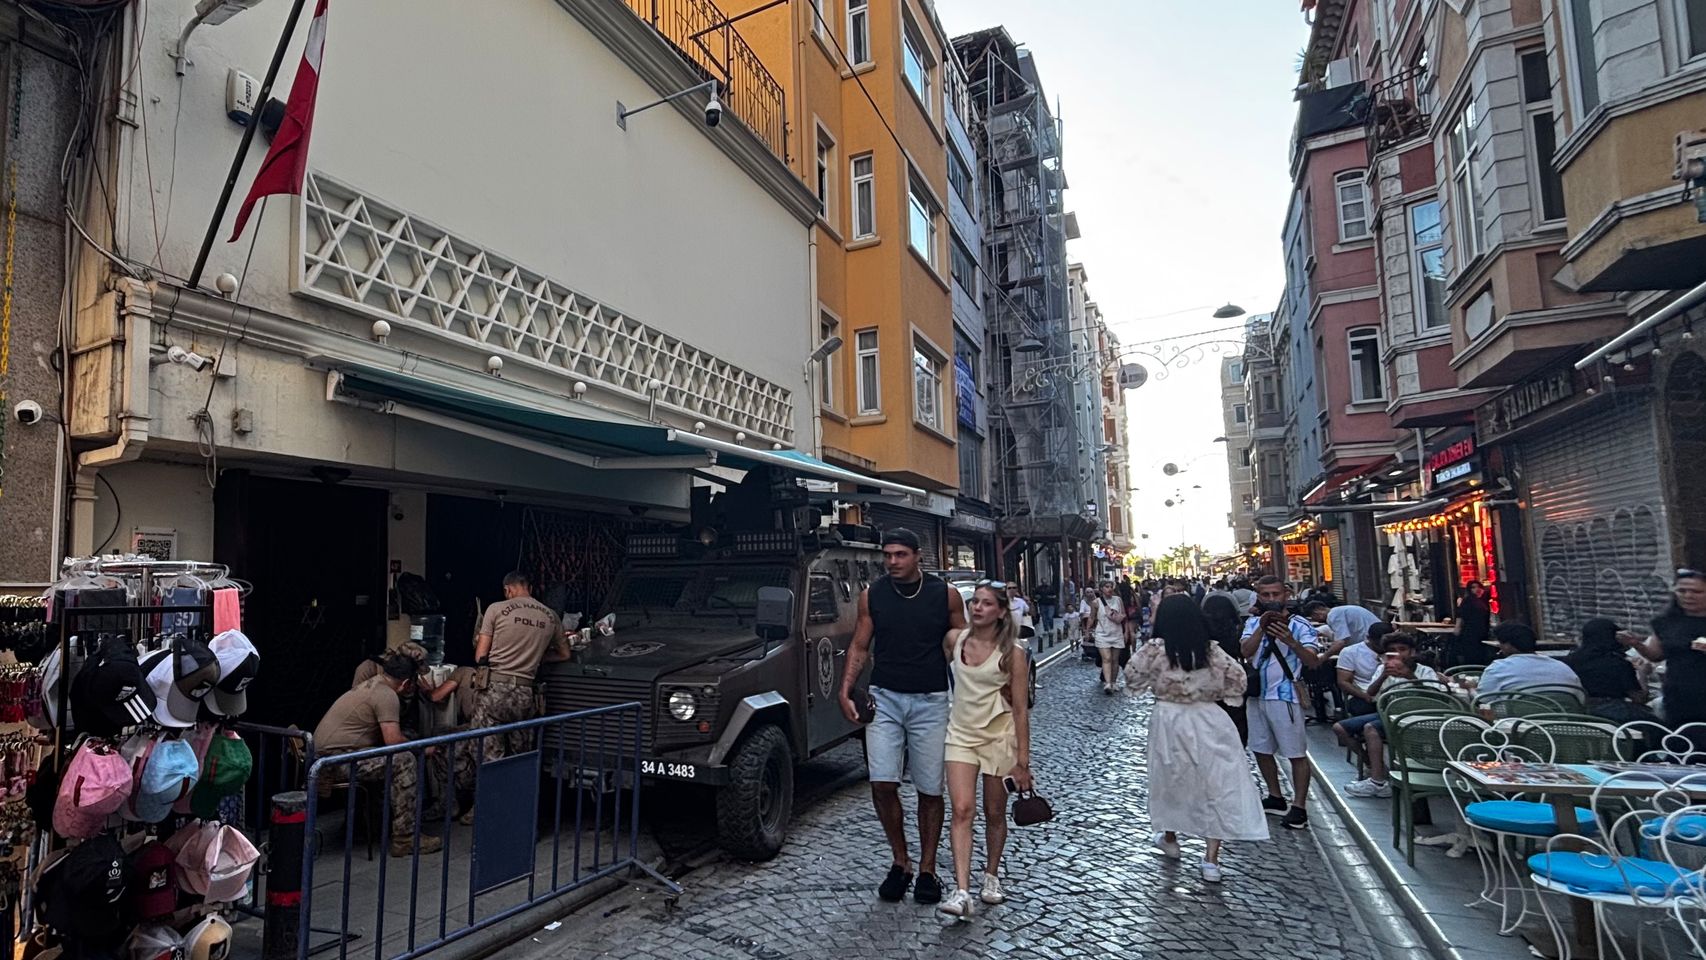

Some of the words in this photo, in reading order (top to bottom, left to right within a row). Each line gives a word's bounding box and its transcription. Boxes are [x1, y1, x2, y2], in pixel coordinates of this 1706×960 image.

[641, 760, 656, 774] 34
[657, 762, 666, 775] A
[668, 763, 695, 778] 3483
